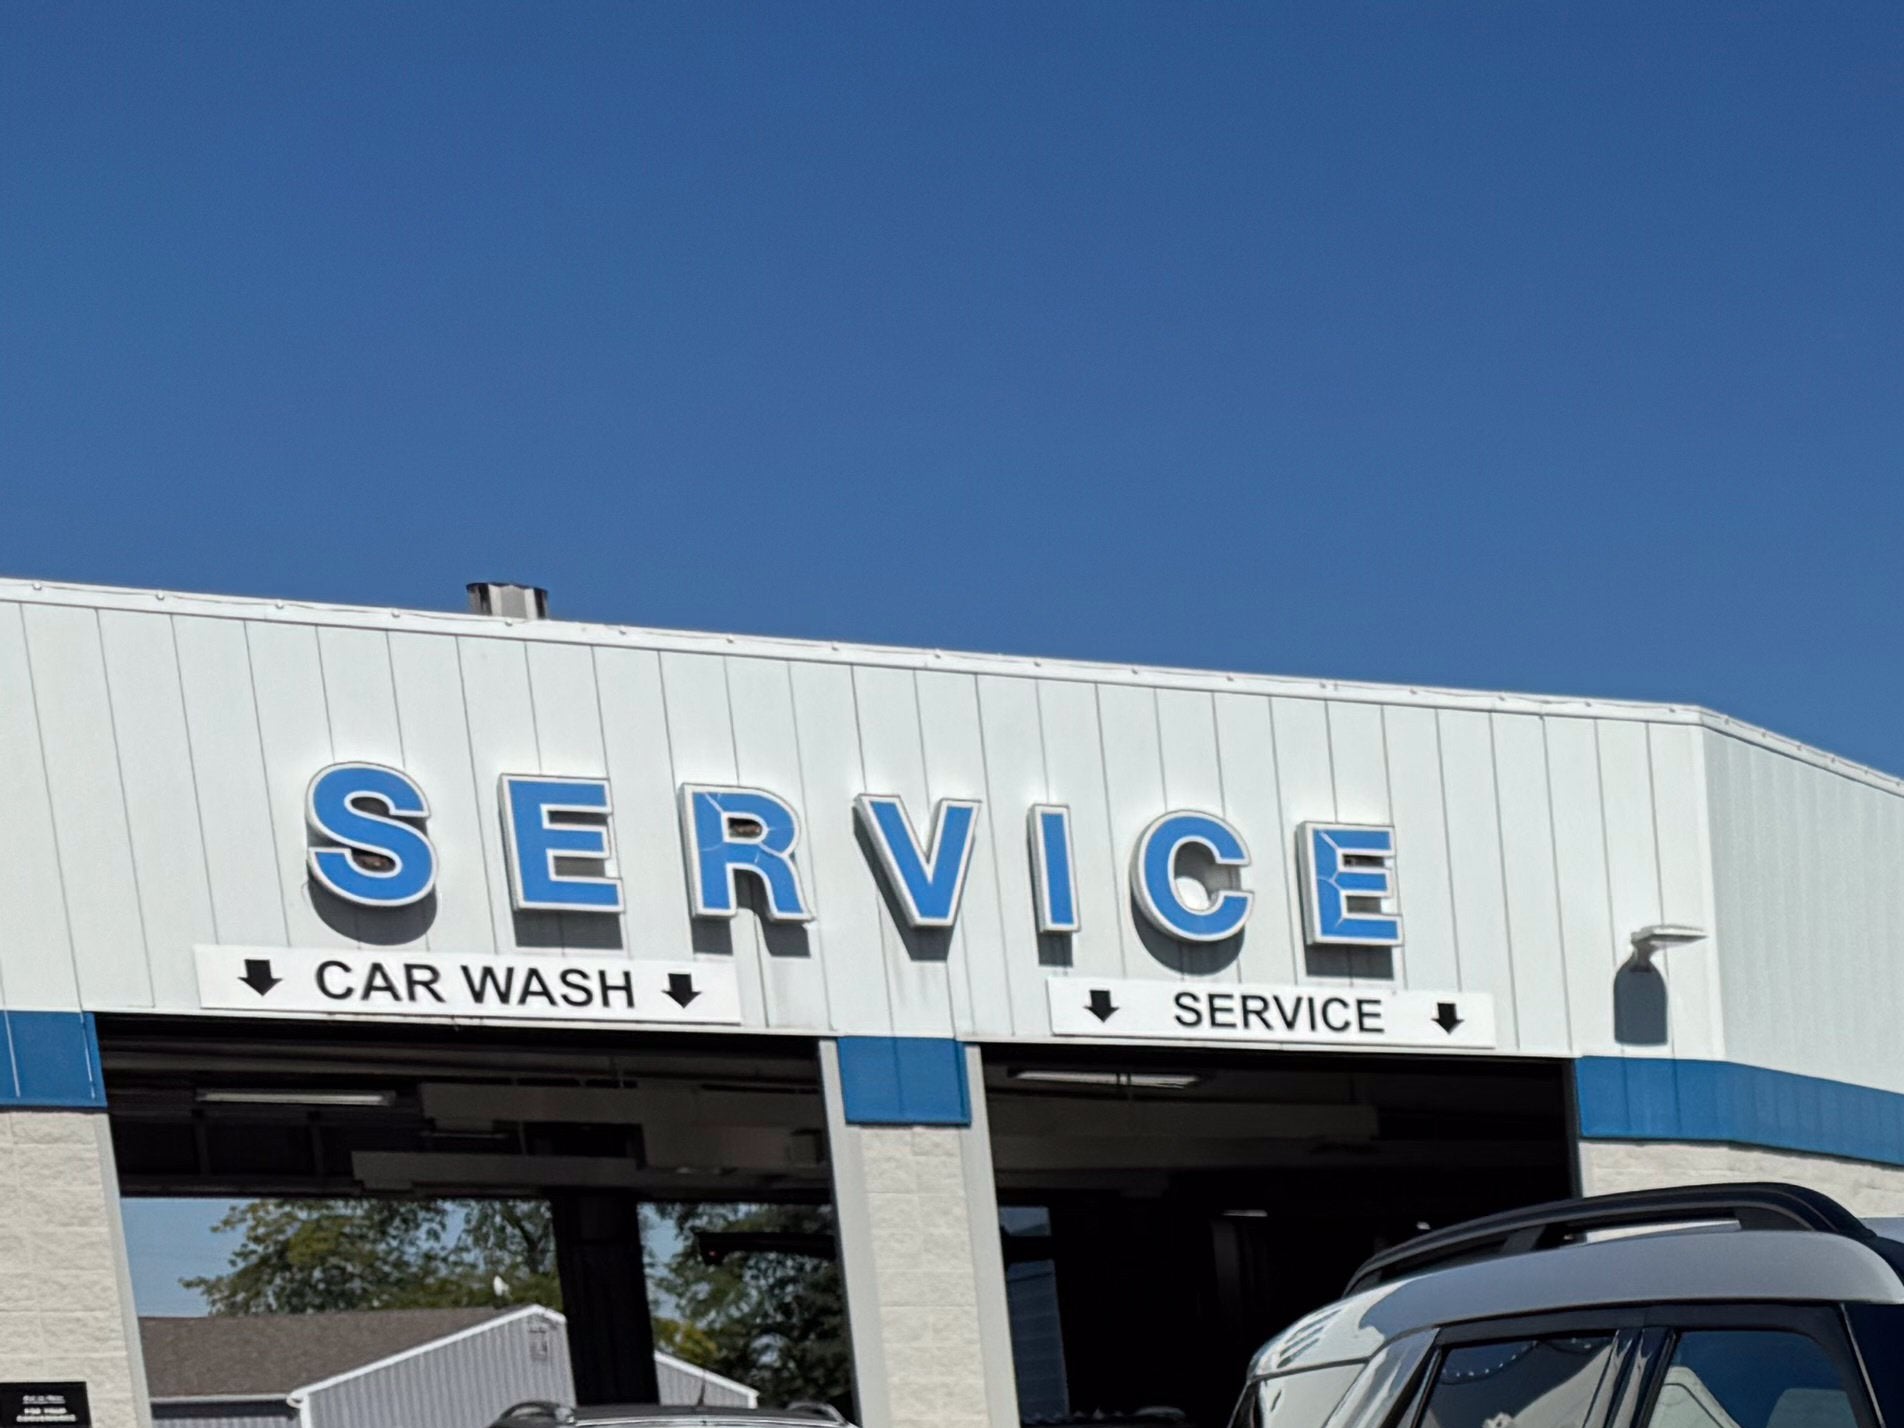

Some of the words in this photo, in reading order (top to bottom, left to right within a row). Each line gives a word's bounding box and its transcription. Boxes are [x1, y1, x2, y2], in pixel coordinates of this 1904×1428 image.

[306, 760, 1403, 947] SERVICE
[314, 959, 446, 1004] CAR
[460, 963, 636, 1009] WASH
[1172, 989, 1387, 1035] SERVICE
